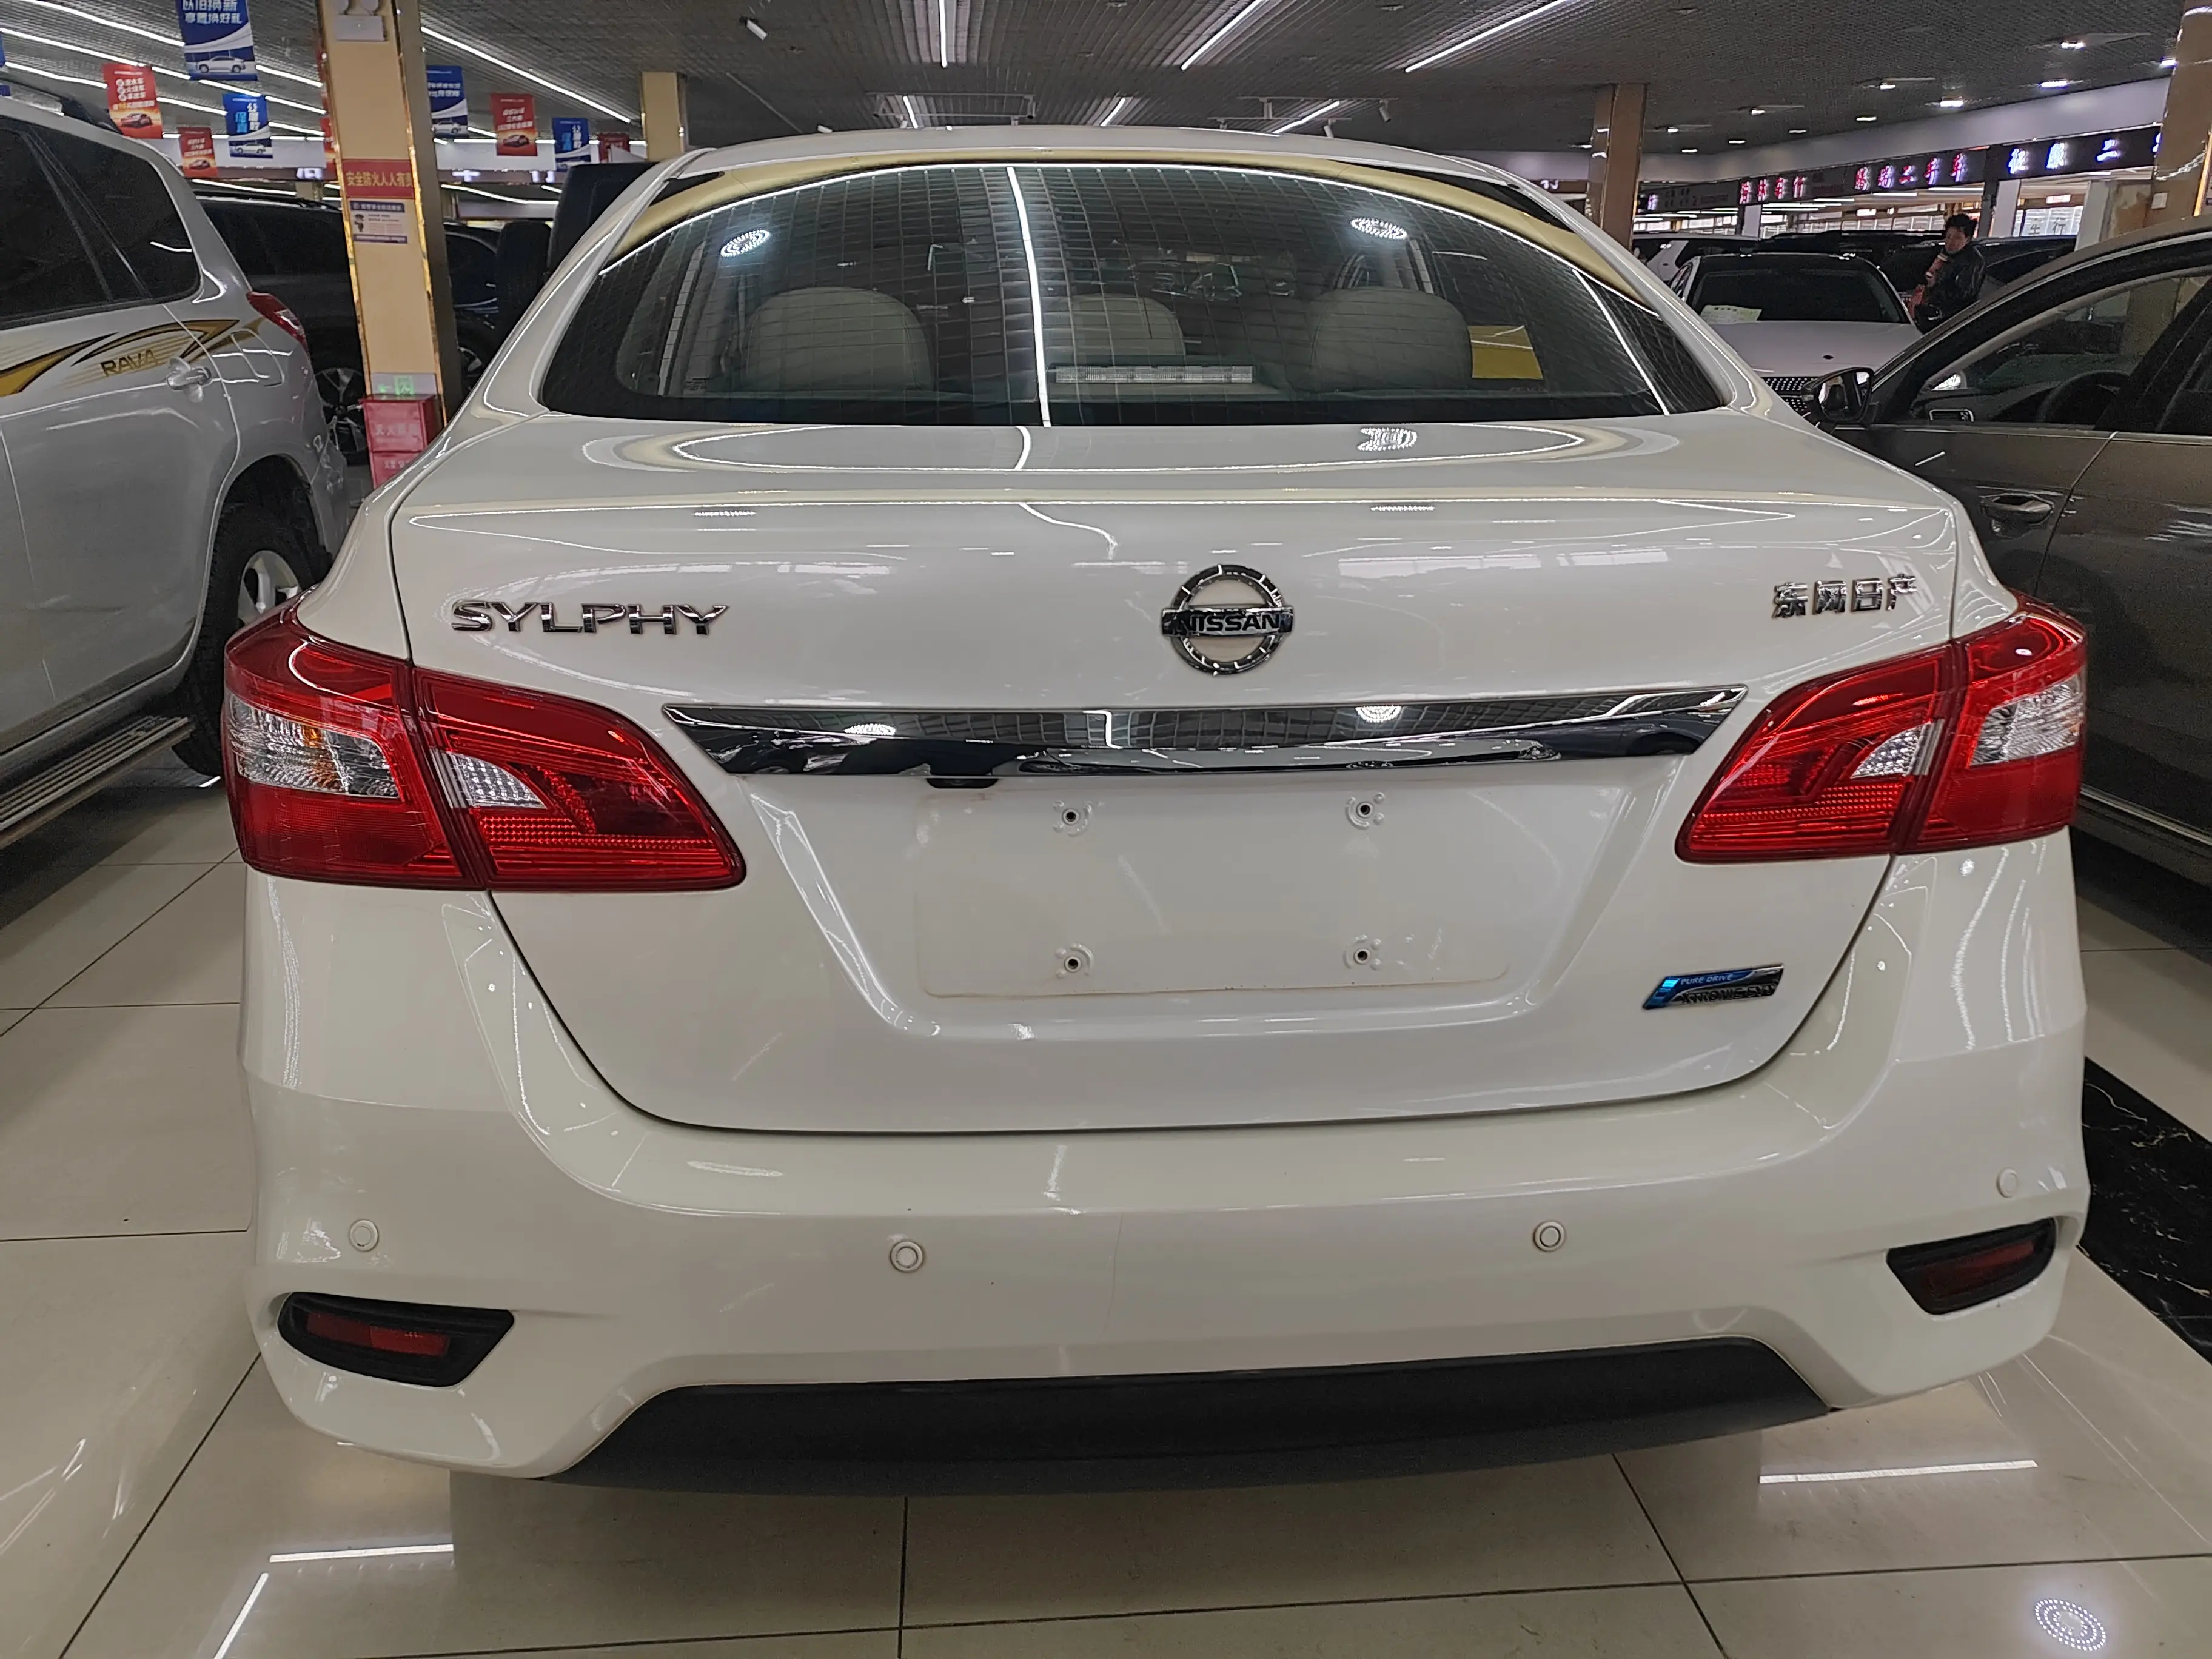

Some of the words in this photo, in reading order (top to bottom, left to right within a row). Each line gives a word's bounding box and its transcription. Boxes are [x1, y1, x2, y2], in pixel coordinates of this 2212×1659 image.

[1771, 573, 1919, 618] 东风日产
[451, 599, 729, 635] SYLPHY
[1176, 612, 1282, 634] NISSAN
[1680, 977, 1705, 985] PURE
[1706, 973, 1734, 983] DRIVE
